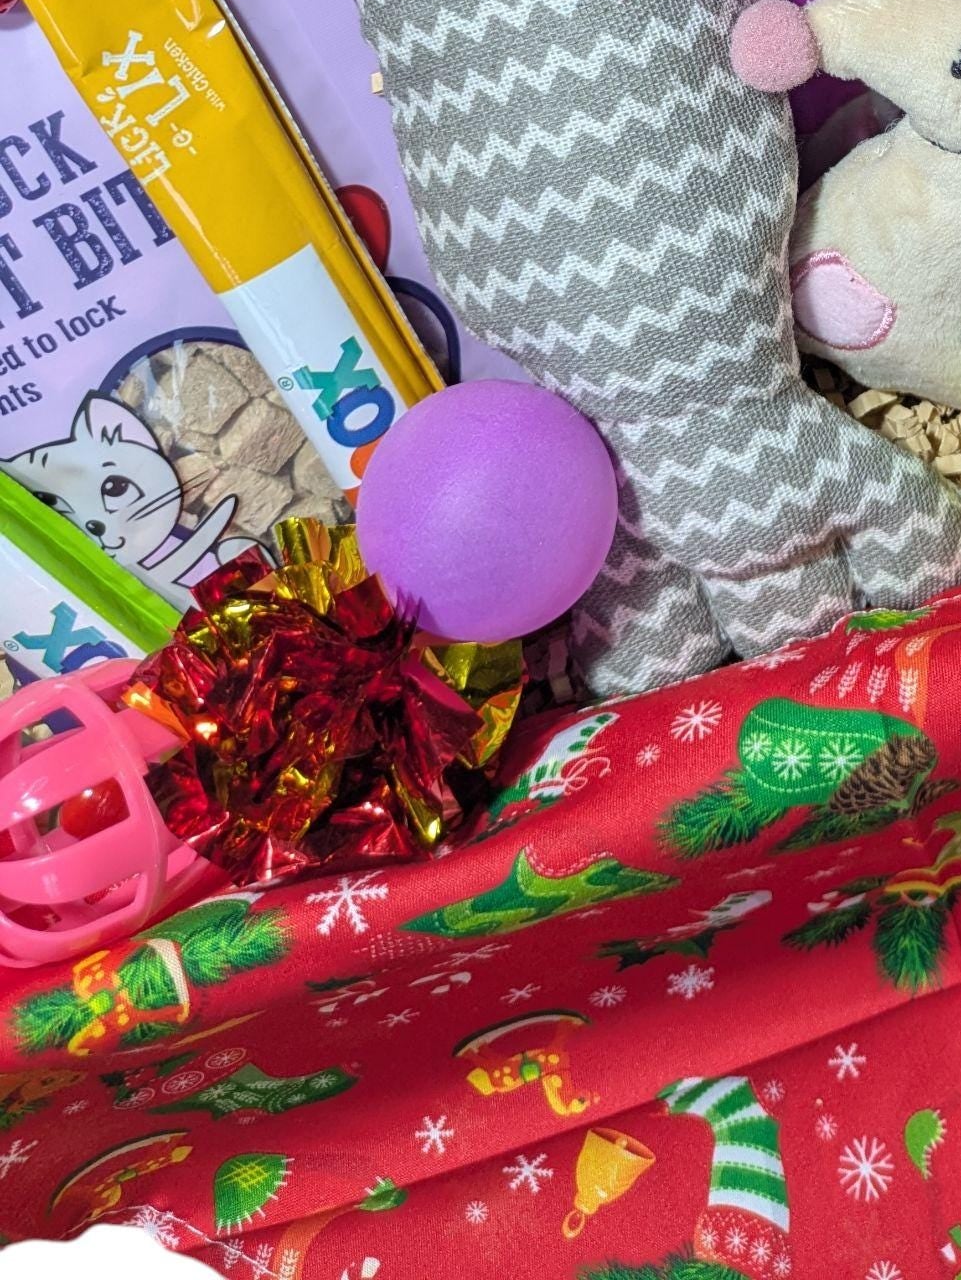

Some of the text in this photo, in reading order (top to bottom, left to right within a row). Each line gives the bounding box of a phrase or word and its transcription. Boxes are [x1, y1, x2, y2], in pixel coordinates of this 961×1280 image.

[163, 36, 227, 112] with Chicken
[0, 109, 99, 220] CK
[22, 333, 59, 359] to
[54, 295, 127, 342] lock
